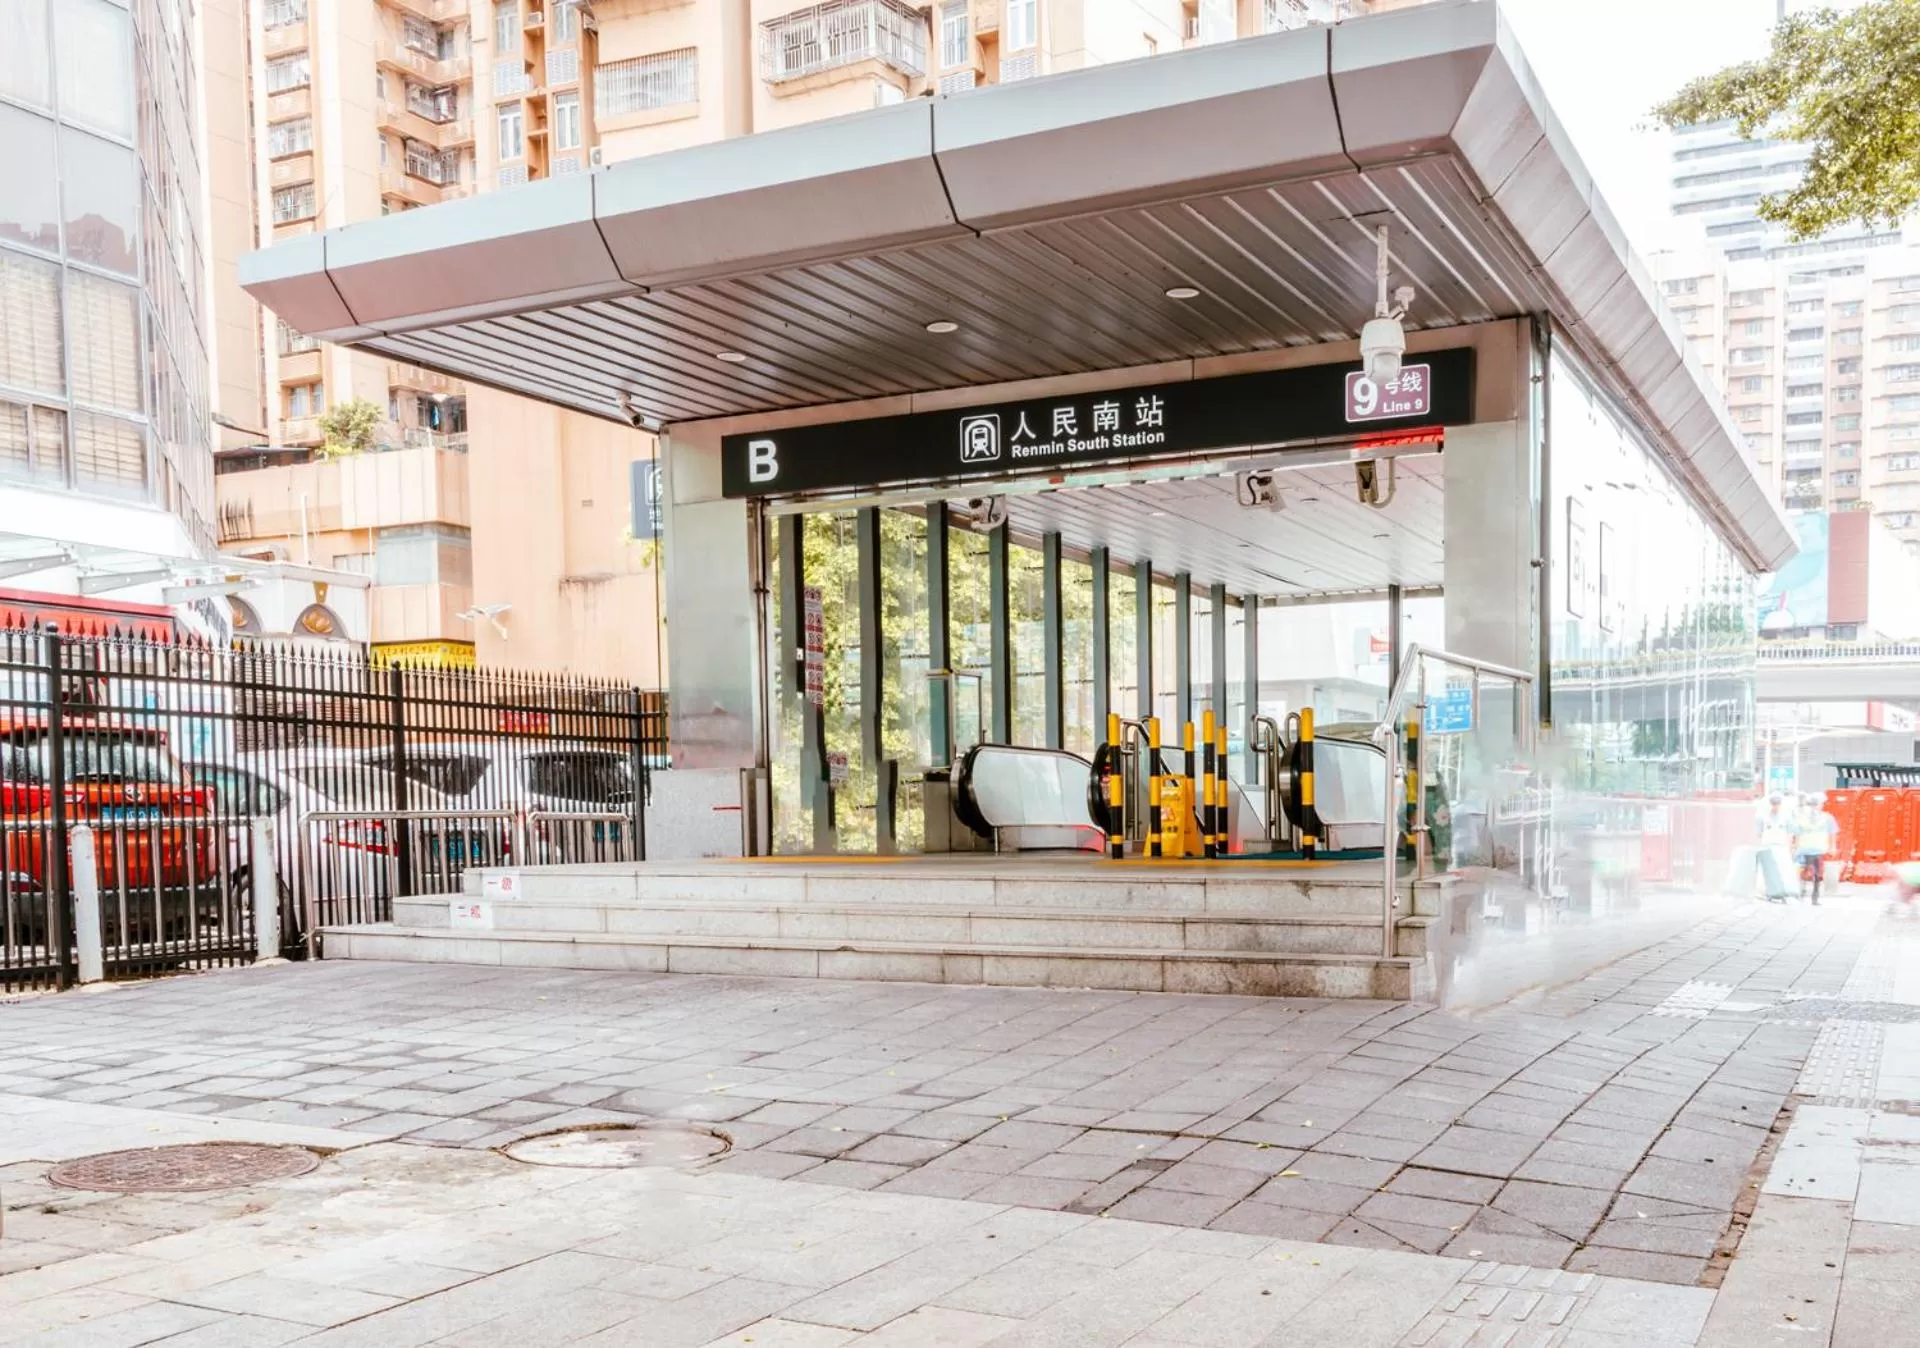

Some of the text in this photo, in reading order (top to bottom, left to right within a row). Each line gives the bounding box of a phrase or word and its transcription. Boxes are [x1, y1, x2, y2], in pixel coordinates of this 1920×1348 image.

[1353, 377, 1378, 415] 9
[1383, 398, 1423, 413] Line 9
[1010, 394, 1165, 442] 人民南站
[748, 439, 779, 482] B
[1011, 431, 1165, 458] Renmin South Station
